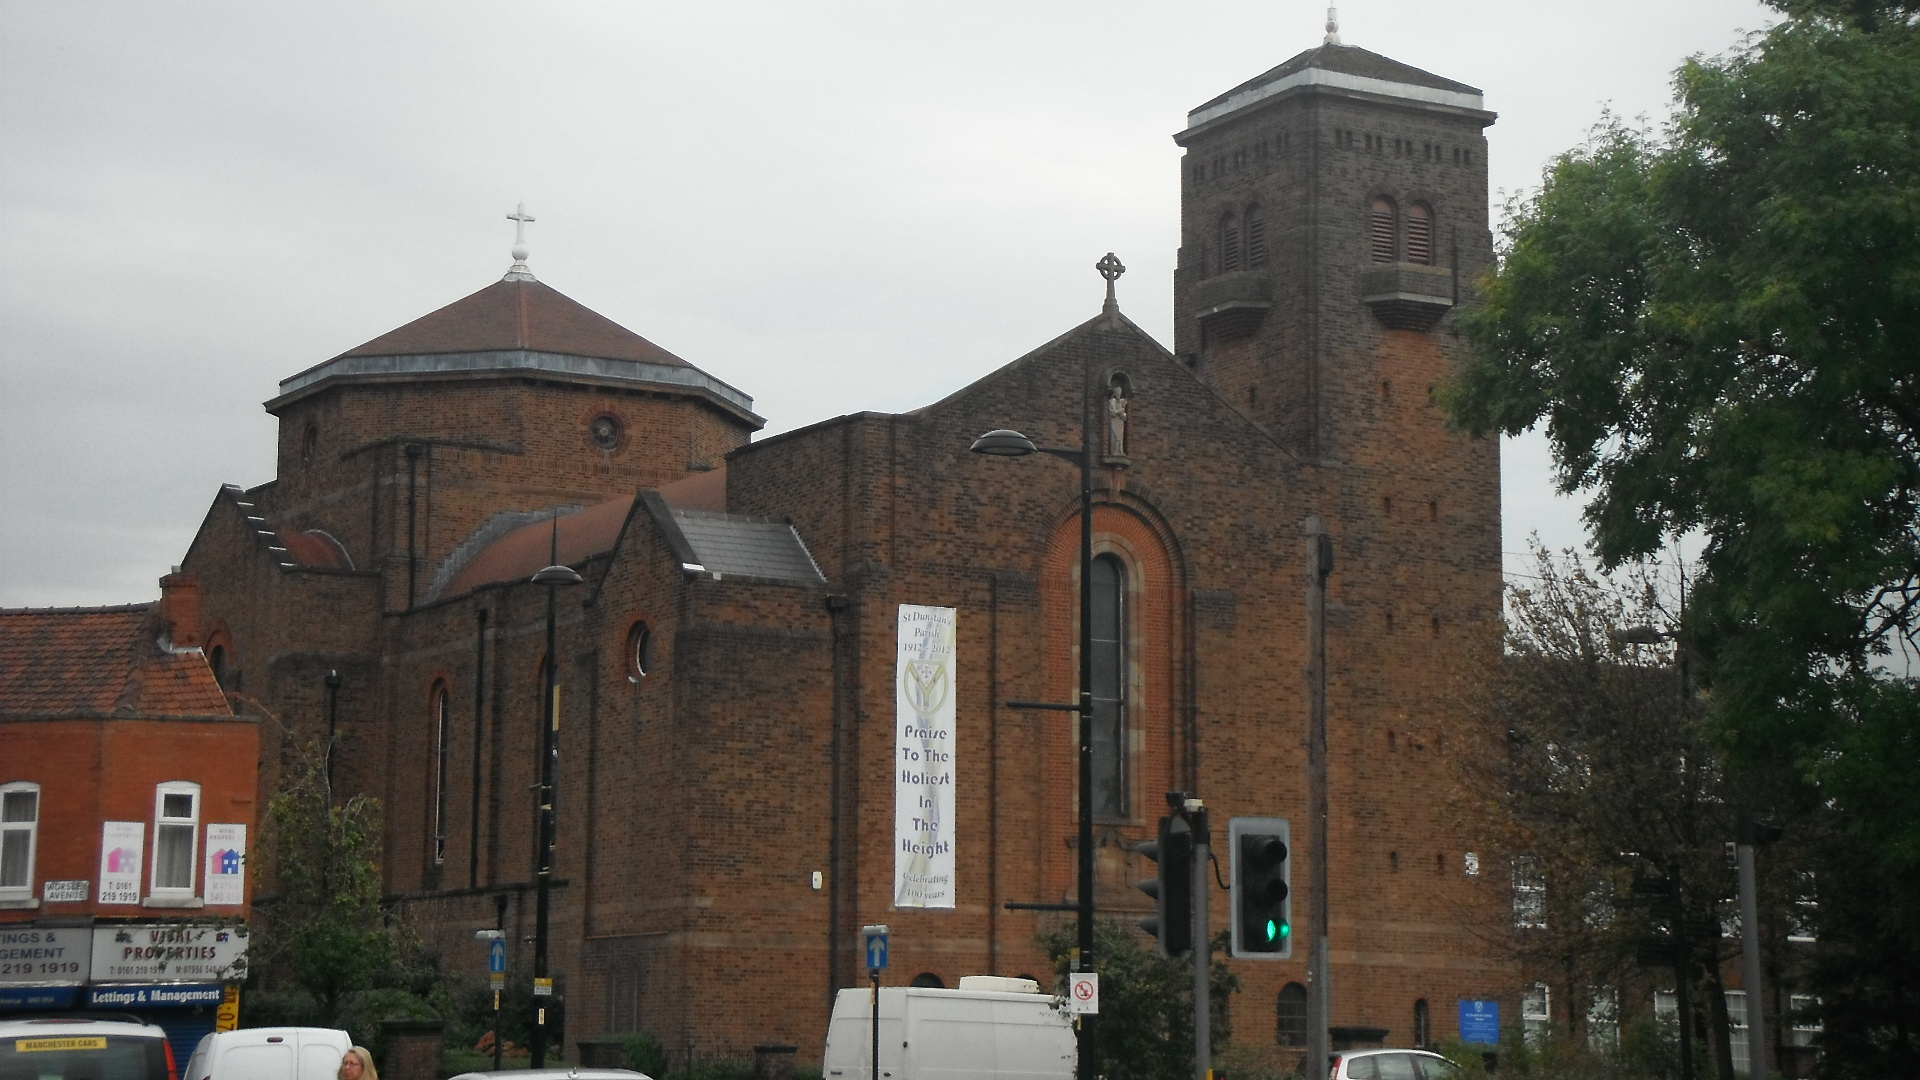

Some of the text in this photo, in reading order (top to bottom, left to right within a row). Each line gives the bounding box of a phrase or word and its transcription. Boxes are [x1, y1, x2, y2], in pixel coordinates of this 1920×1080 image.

[902, 612, 951, 625] St Dunstan's
[914, 627, 940, 638] Parish
[903, 643, 922, 652] 1912
[931, 644, 950, 653] 2012
[904, 724, 947, 739] Praise
[902, 747, 949, 762] To The
[902, 770, 949, 785] Holiest
[919, 795, 932, 808] In
[912, 817, 938, 831] The
[902, 838, 949, 859] Height
[47, 882, 88, 891] WORSLEY
[49, 890, 84, 899] AVENUE
[102, 891, 137, 901] 219 1919
[907, 888, 945, 899] 100 years
[0, 932, 56, 944] INGS &
[124, 947, 216, 959] PROERTIES
[2, 962, 79, 974] 219 1919
[93, 989, 220, 1004] Lettings & Management
[25, 1040, 76, 1049] MANCHESTER
